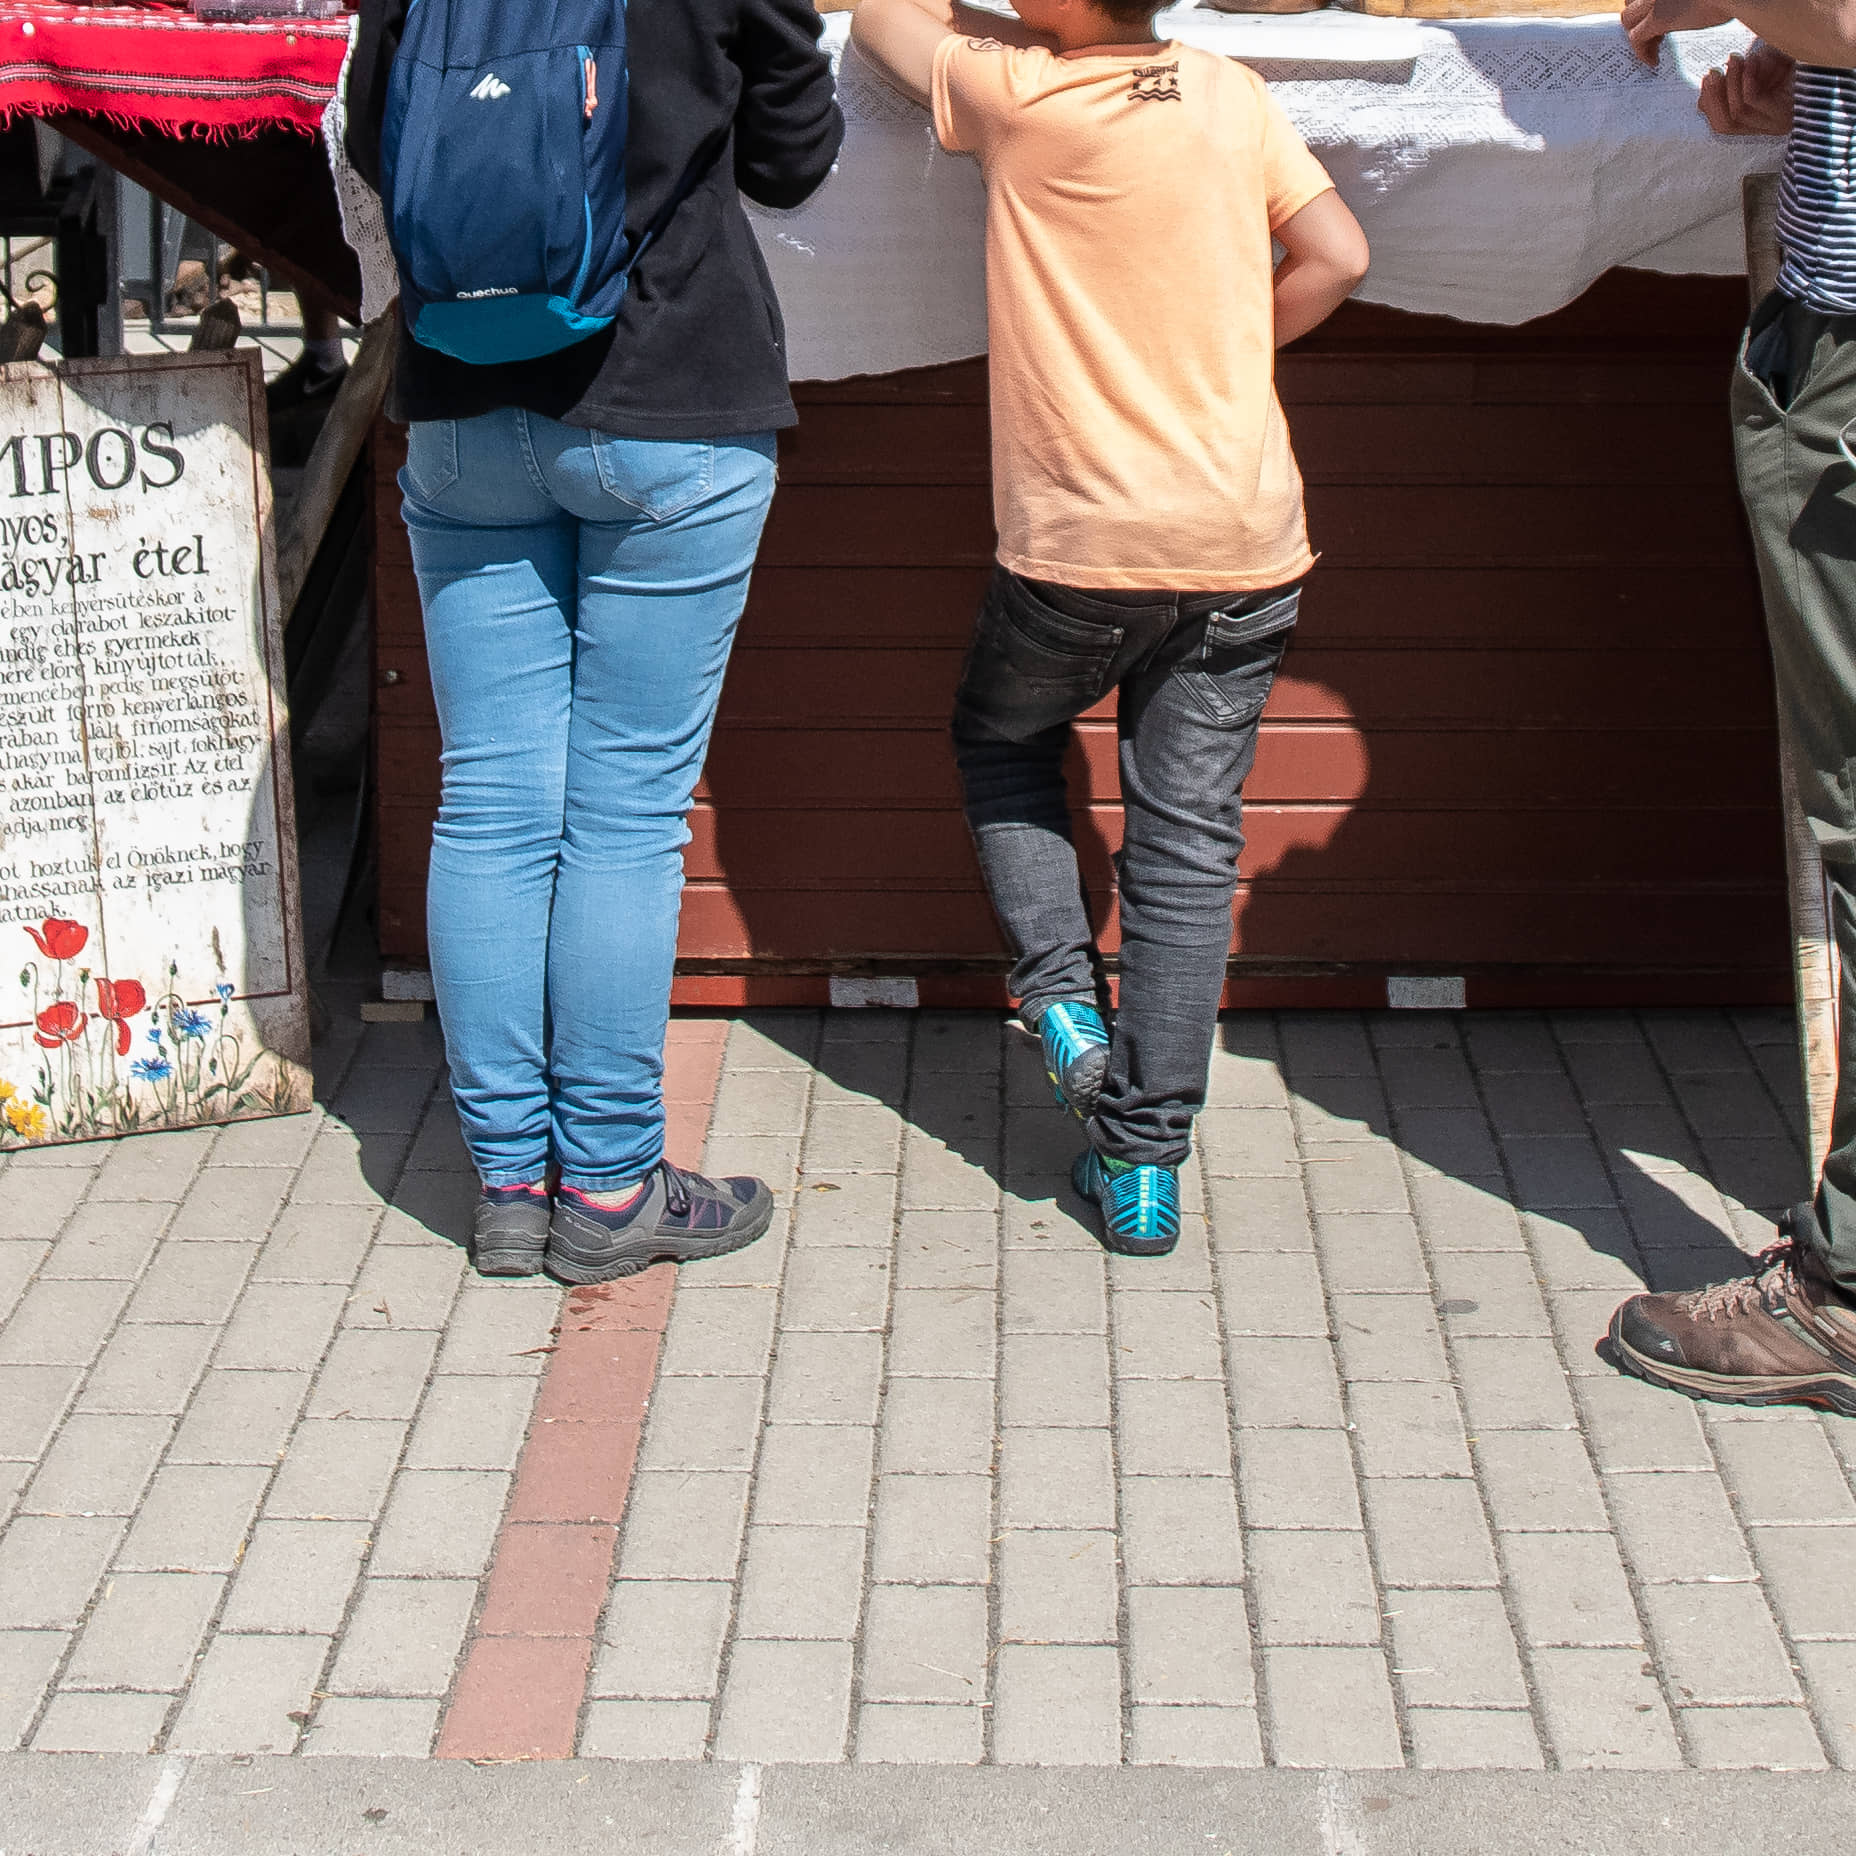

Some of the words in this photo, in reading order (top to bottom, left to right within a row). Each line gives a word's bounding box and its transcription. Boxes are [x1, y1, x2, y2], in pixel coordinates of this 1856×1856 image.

[455, 286, 520, 300] Quechua
[131, 534, 210, 581] étel
[8, 623, 44, 645] egy
[50, 614, 129, 637] darabot
[103, 629, 202, 658] gyermekek
[8, 789, 94, 814] azonban
[29, 854, 99, 879] hoztuk
[105, 851, 122, 870] el
[218, 839, 266, 862] hogy
[112, 874, 137, 890] az
[145, 864, 194, 893] igazi
